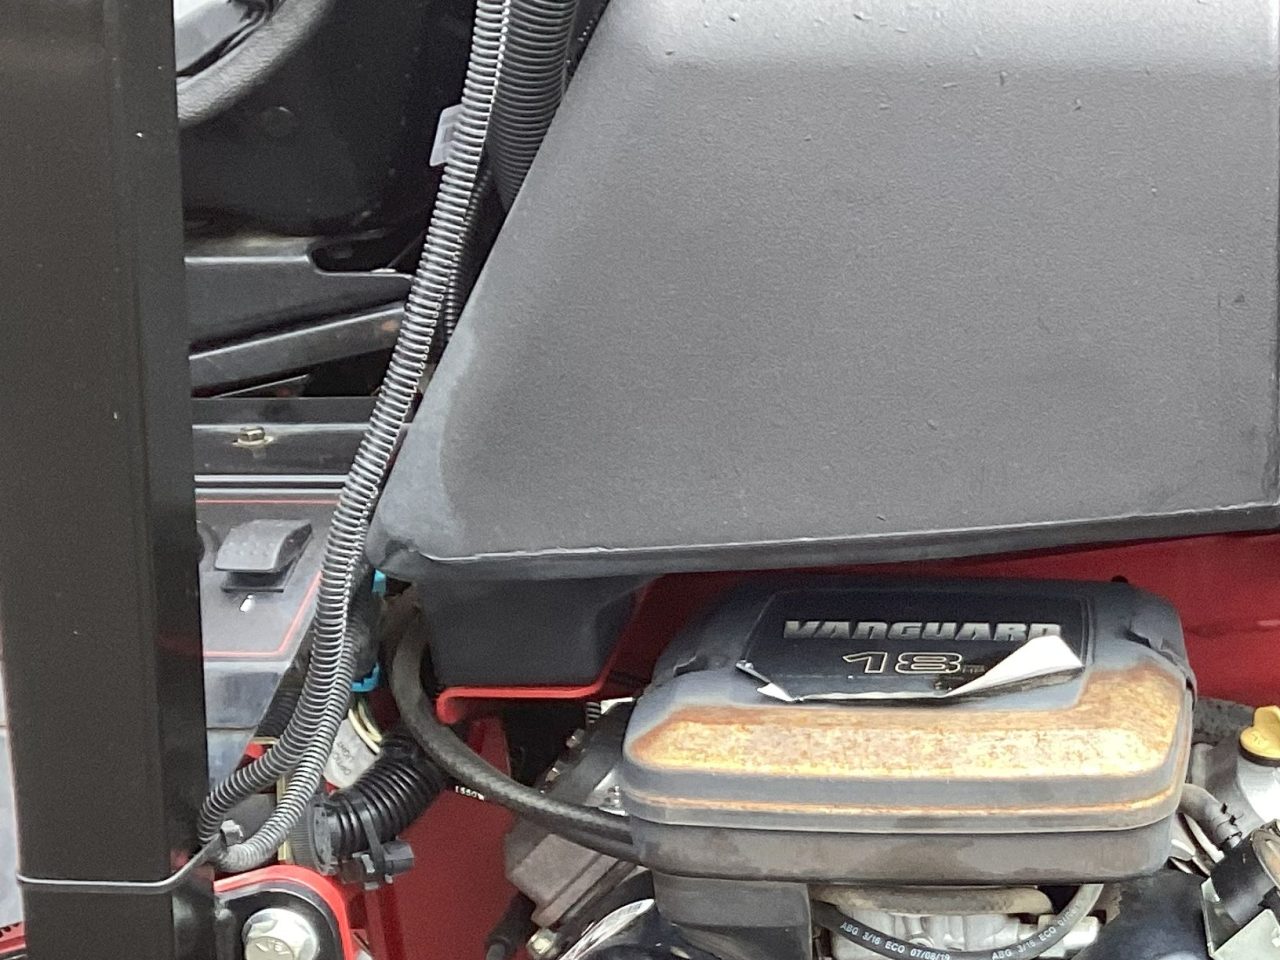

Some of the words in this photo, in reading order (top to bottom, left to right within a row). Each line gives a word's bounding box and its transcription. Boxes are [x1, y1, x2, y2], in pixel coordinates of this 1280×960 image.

[784, 621, 1062, 641] VANGUARD
[843, 651, 962, 674] 18
[862, 931, 881, 945] 3/16
[884, 940, 906, 954] ECO
[1038, 926, 1057, 942] ECO
